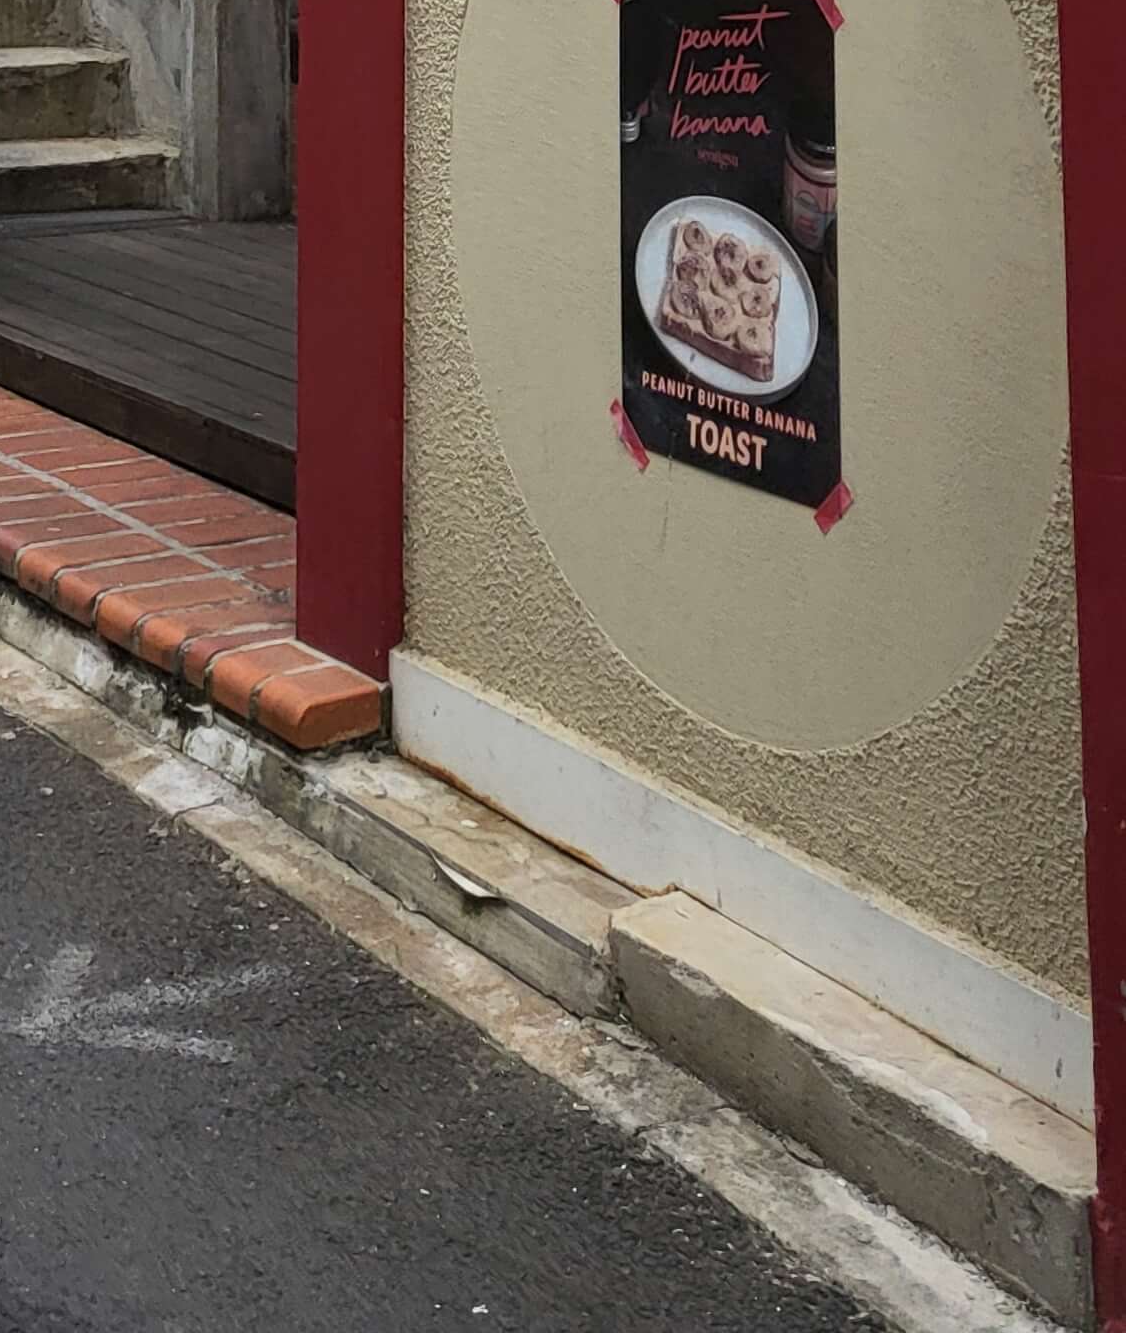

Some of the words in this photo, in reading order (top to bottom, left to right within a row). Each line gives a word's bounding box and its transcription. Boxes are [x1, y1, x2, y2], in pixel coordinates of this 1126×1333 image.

[669, 3, 791, 94] peanut
[685, 53, 773, 96] butter
[670, 100, 773, 139] banana
[641, 370, 694, 403] PEANUT
[697, 388, 750, 422] BUTTER
[755, 406, 817, 442] BANANA
[686, 412, 768, 471] TOAST
